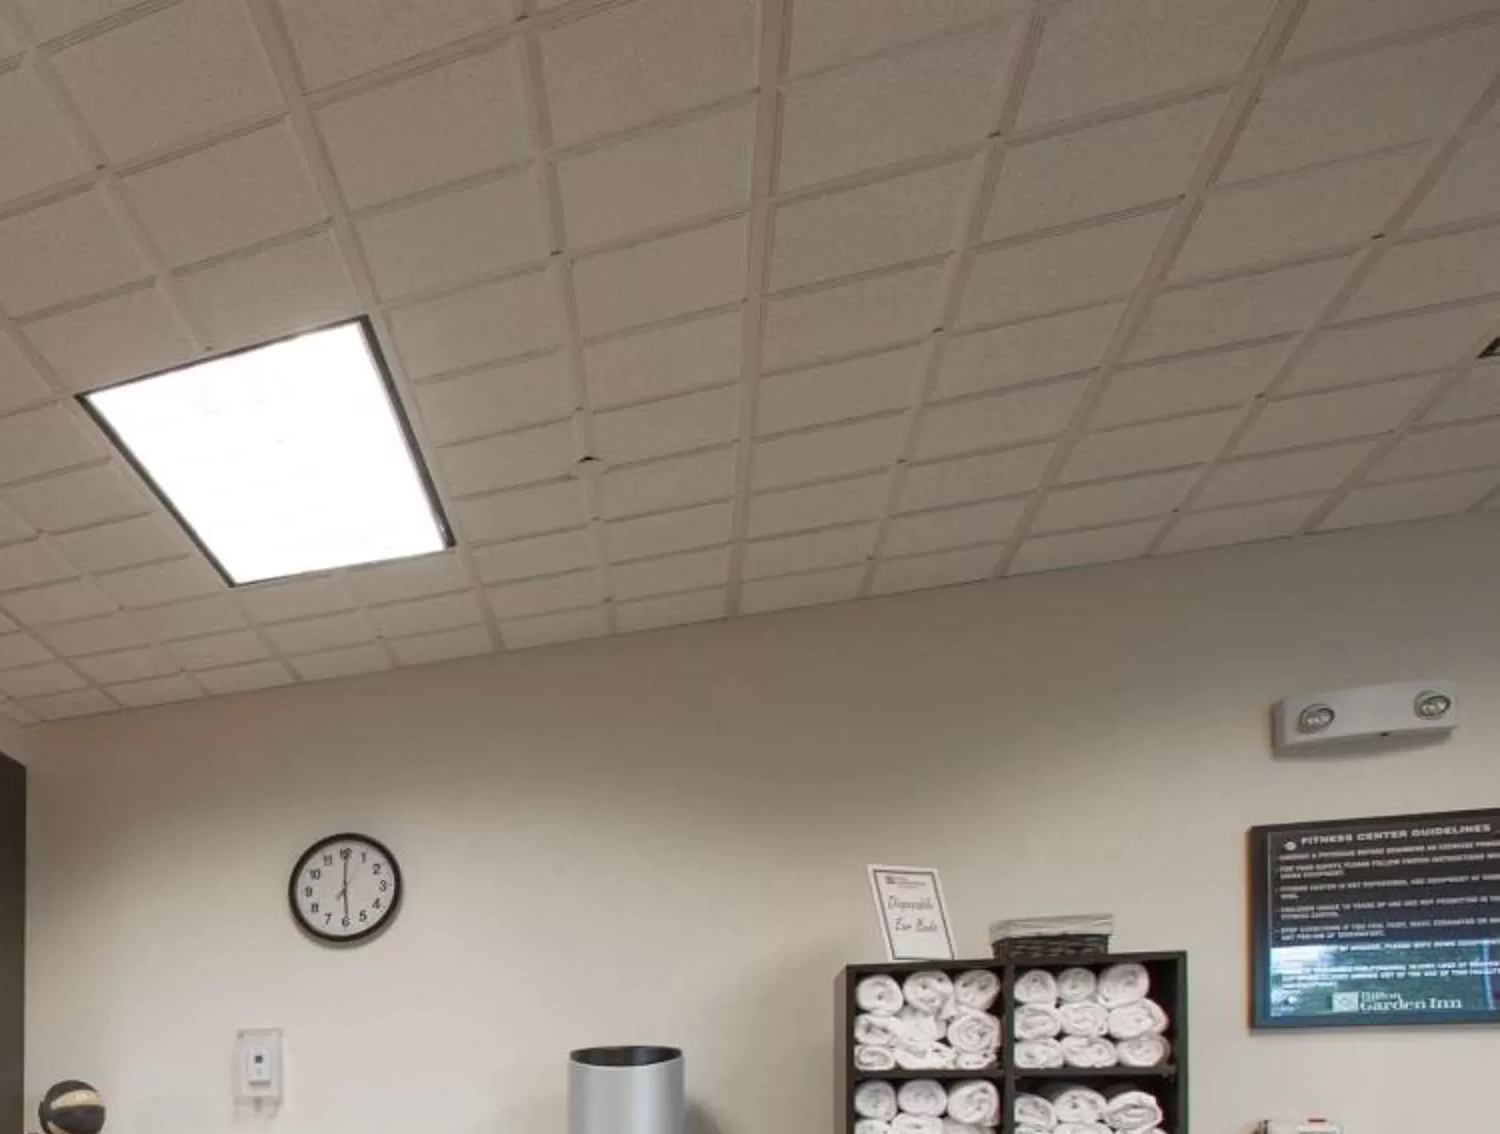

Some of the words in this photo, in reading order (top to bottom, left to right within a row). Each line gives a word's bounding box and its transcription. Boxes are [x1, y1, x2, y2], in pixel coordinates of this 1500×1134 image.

[1301, 833, 1353, 845] FITNESS
[1356, 829, 1408, 841] CENTER
[1411, 823, 1491, 837] GUIDELINES
[371, 863, 381, 875] 2
[379, 879, 388, 892] 3
[371, 897, 381, 909] 4
[323, 912, 333, 925] 7
[341, 915, 351, 927] 6
[359, 910, 368, 922] 5
[1360, 996, 1427, 1011] Garden
[1428, 997, 1462, 1009] Inn
